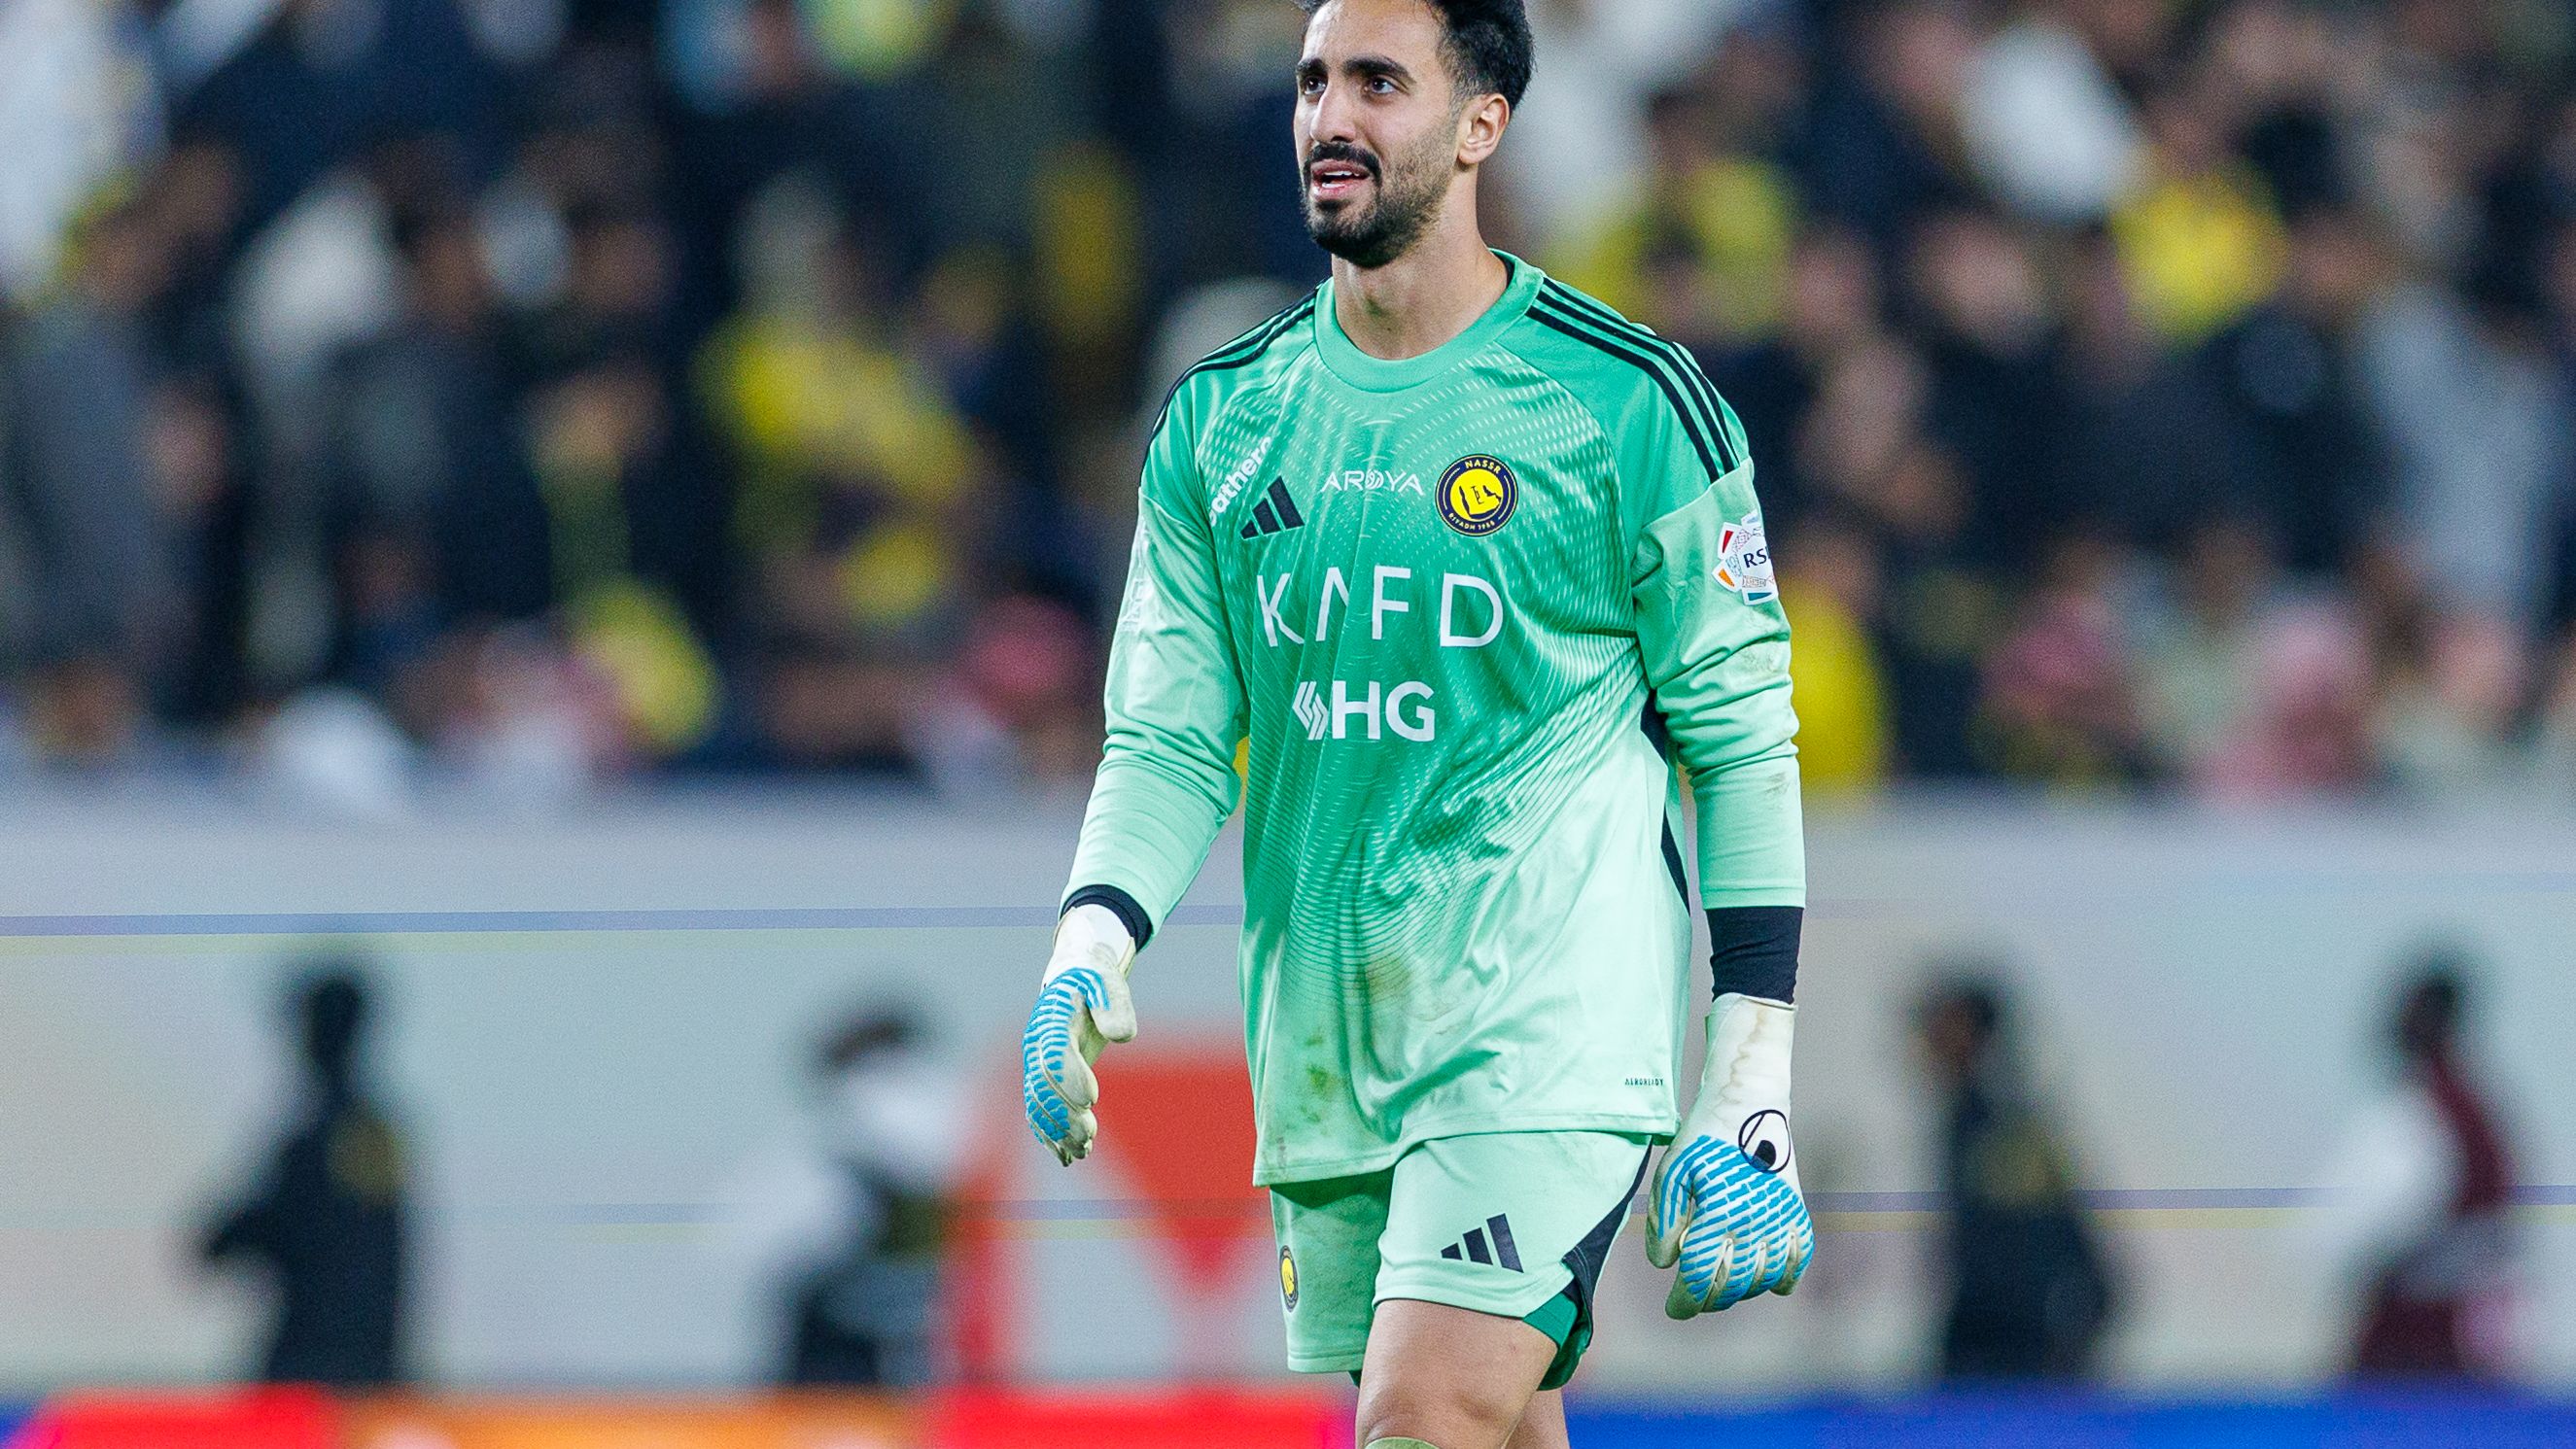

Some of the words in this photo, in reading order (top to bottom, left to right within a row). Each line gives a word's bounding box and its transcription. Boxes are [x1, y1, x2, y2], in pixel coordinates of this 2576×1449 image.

[1465, 459, 1501, 474] NASSR
[1320, 470, 1425, 496] AROYA
[1332, 680, 1436, 742] HG
